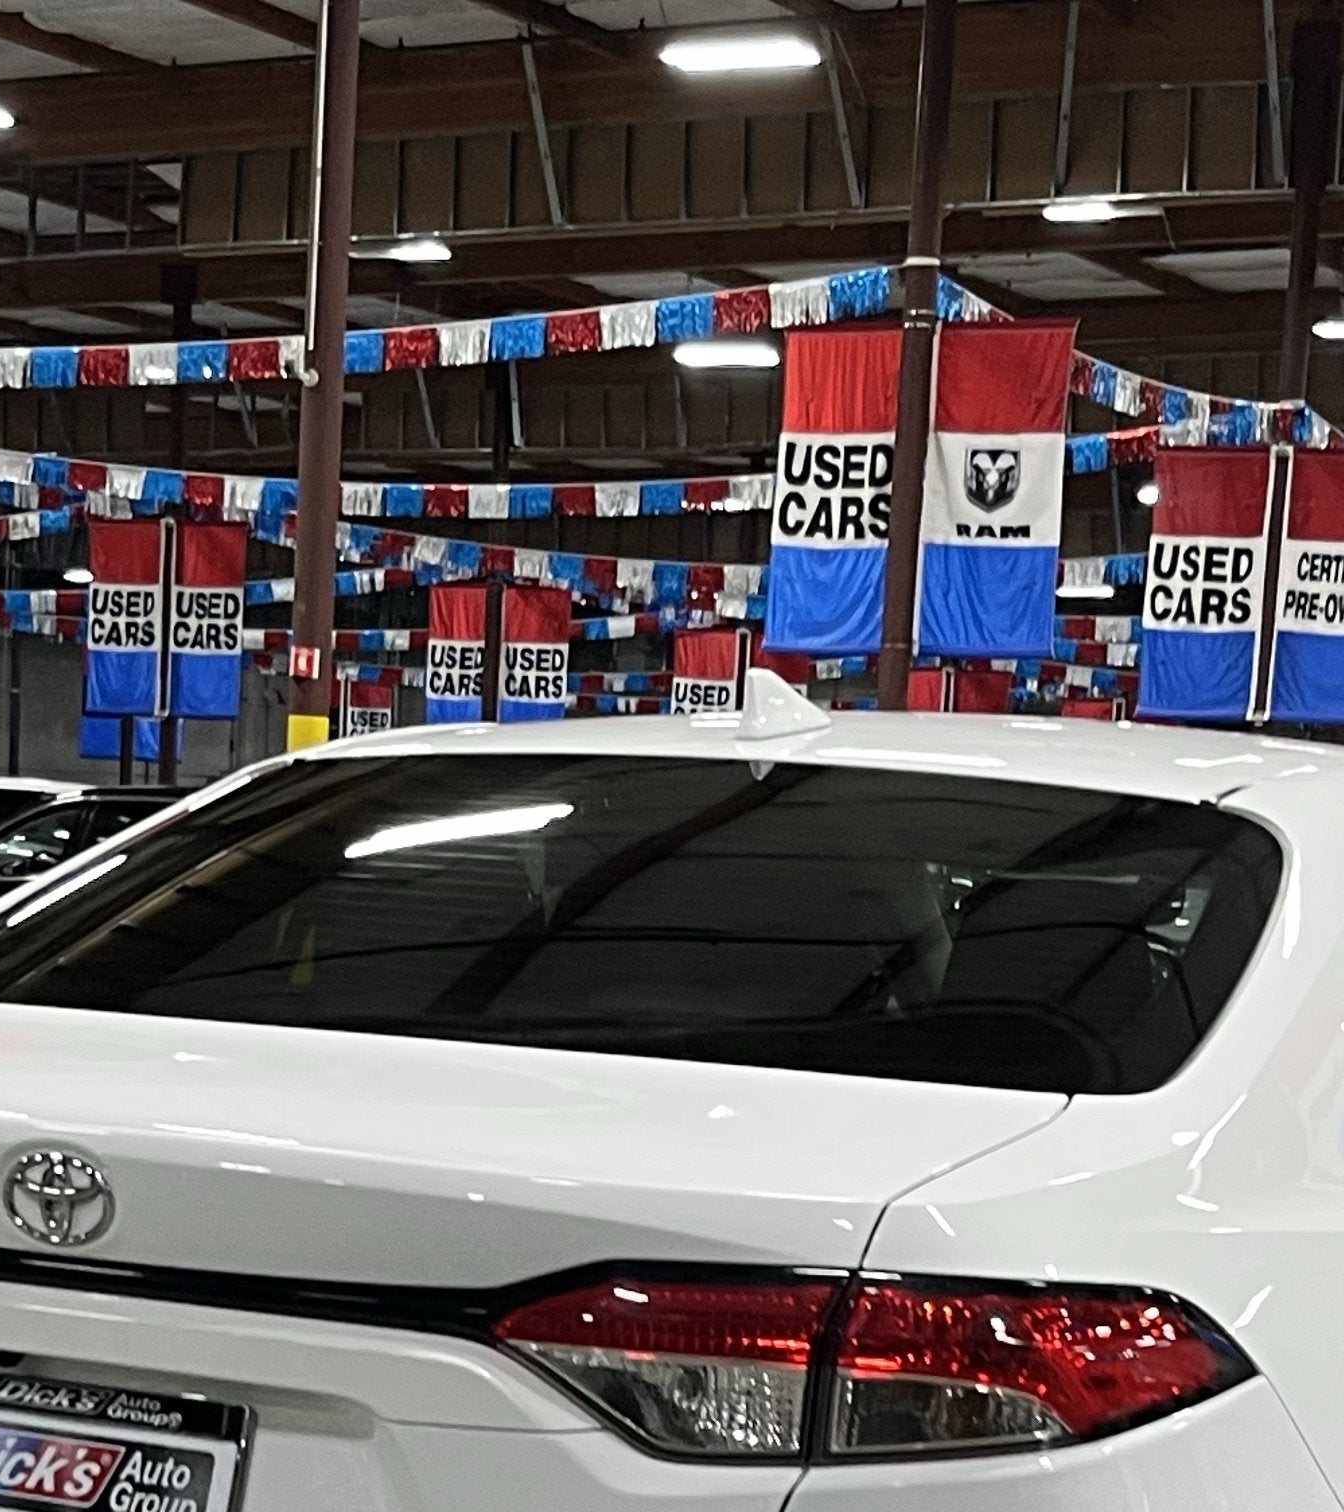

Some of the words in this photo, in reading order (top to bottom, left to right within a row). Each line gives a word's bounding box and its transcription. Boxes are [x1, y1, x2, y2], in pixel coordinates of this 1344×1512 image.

[784, 442, 893, 490] USED
[778, 492, 891, 540] CARS
[956, 523, 1031, 538] RAM
[1153, 543, 1254, 583] USED
[91, 588, 155, 617] USED
[175, 591, 240, 620] USED
[1150, 585, 1252, 624] CARS
[91, 618, 155, 647] CARS
[173, 622, 238, 650] CARS
[430, 645, 484, 669] USED
[506, 646, 564, 672] USED
[429, 672, 483, 696] CARS
[505, 674, 563, 699] CARS
[675, 683, 730, 706] USED
[350, 711, 388, 727] USED
[107, 1403, 169, 1428] Group
[115, 1393, 161, 1412] Auto
[119, 1450, 191, 1490] Auto
